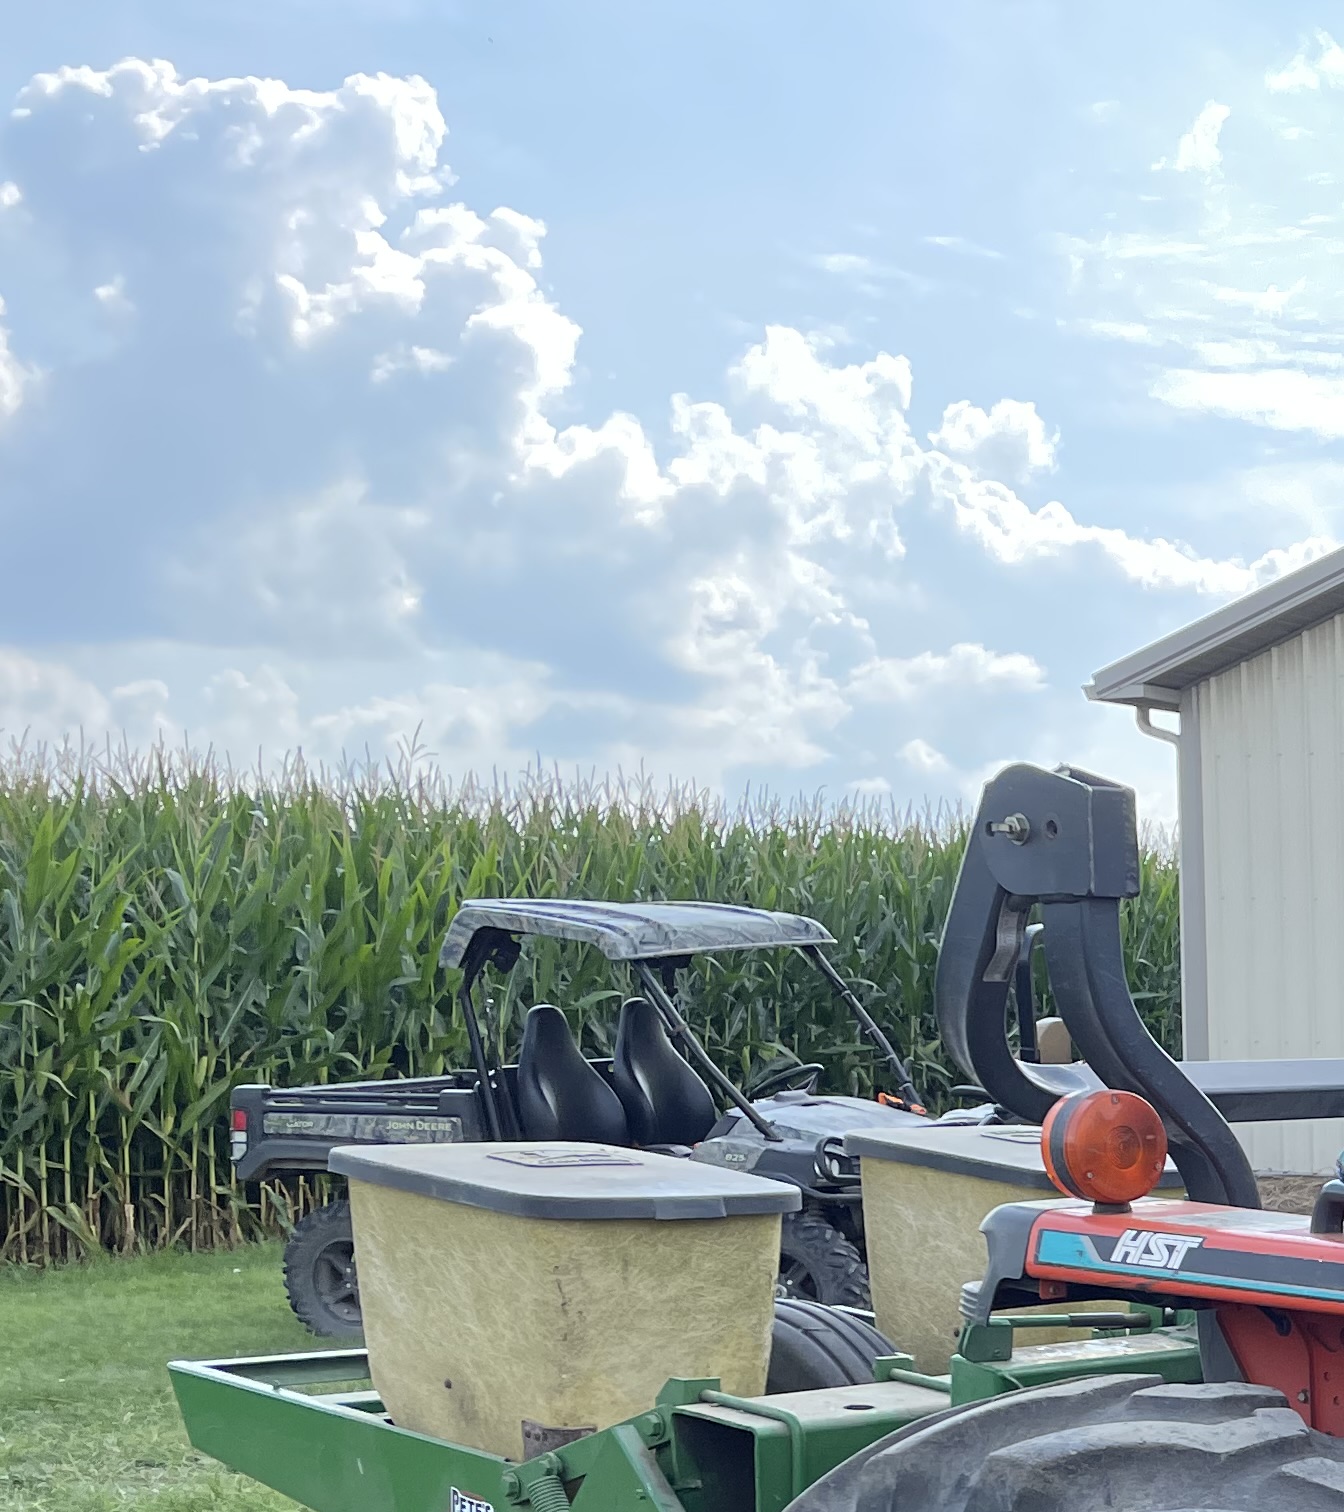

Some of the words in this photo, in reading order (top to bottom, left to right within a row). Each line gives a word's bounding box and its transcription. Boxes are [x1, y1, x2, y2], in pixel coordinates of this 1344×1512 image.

[386, 1120, 415, 1130] JOHN
[416, 1120, 452, 1132] DEERE
[1110, 1228, 1203, 1270] HST
